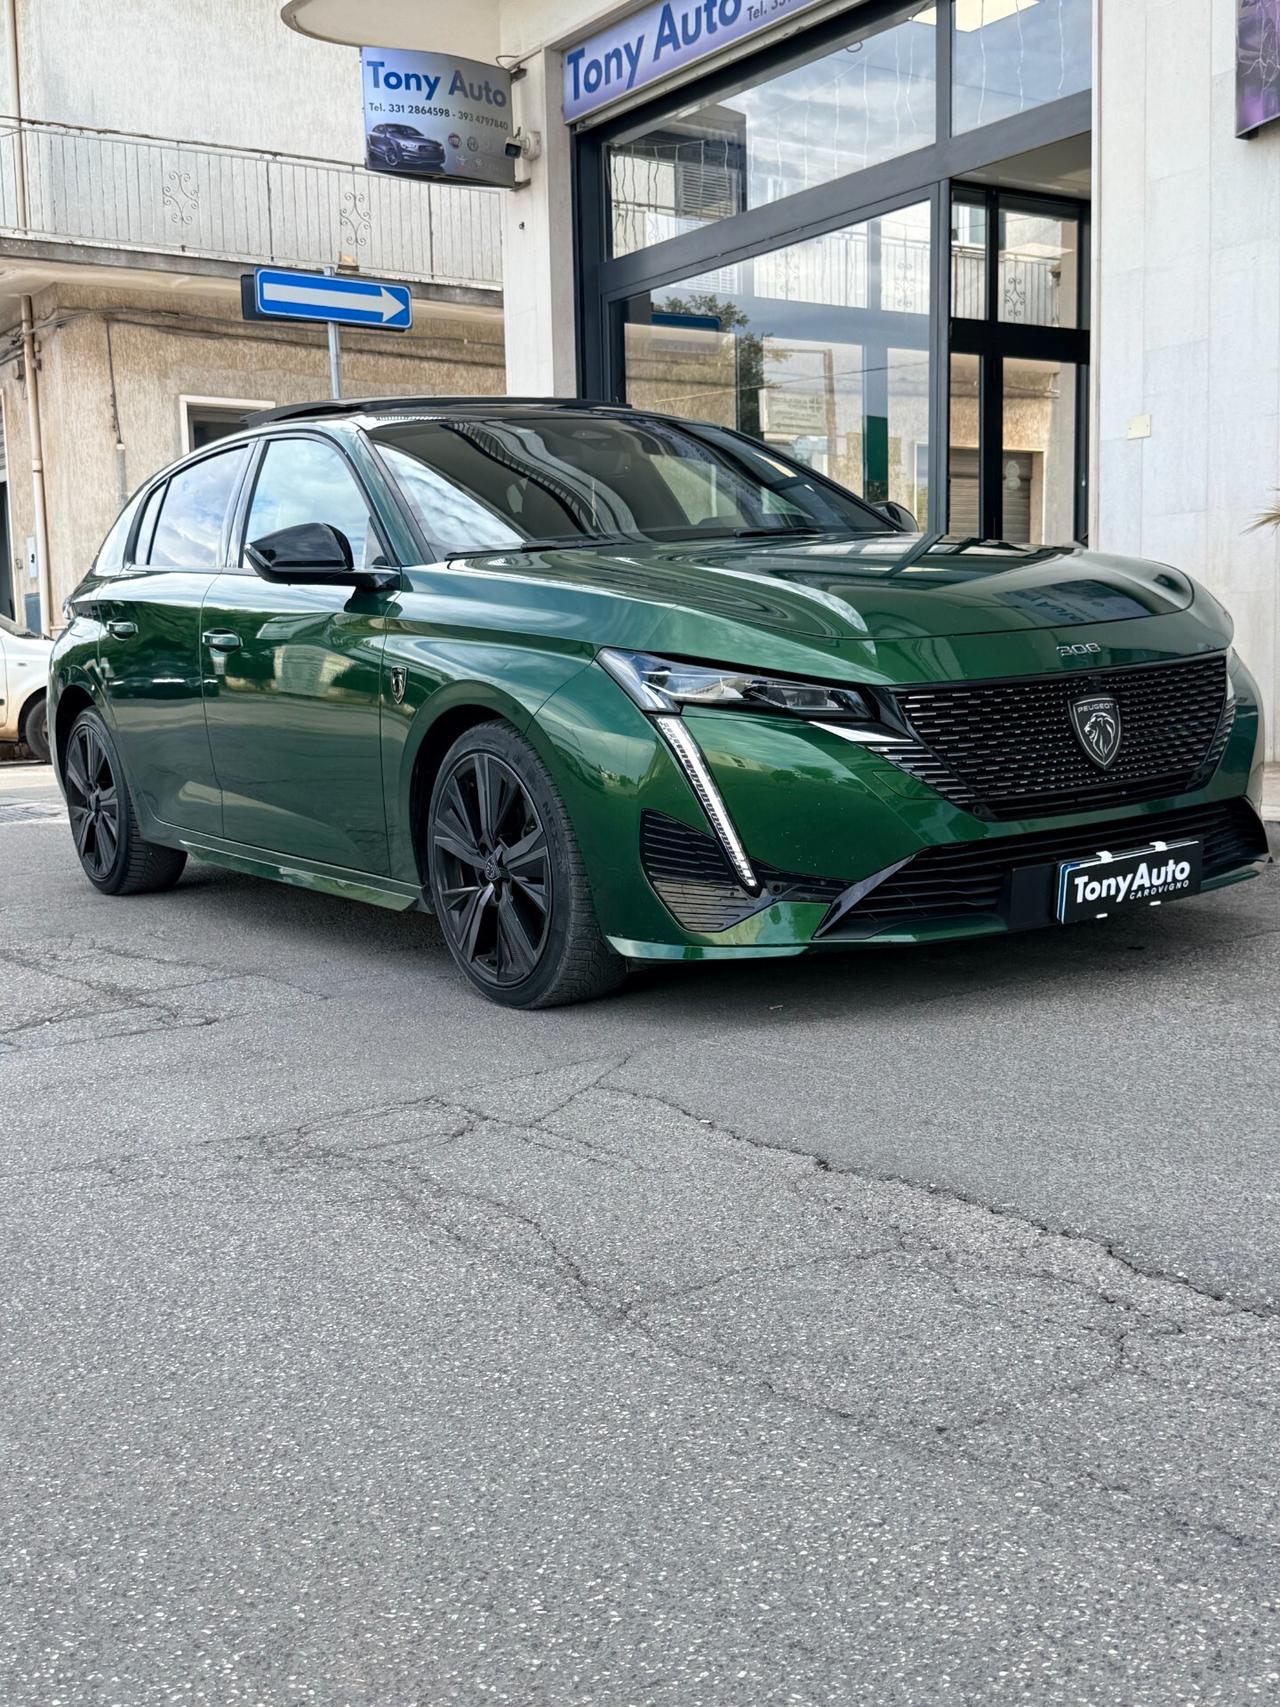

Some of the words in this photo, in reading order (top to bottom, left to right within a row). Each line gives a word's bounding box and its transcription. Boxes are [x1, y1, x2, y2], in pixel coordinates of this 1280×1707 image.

[746, 0, 767, 21] Tel.
[567, 34, 645, 101] Tony
[652, 0, 742, 63] Auto
[366, 60, 441, 101] Tony
[448, 69, 507, 108] Auto
[369, 102, 386, 113] Tel.
[388, 103, 405, 114] 331
[408, 104, 450, 118] 2864598
[458, 110, 474, 122] 393
[1056, 642, 1101, 657] 308
[1077, 702, 1114, 713] PEUGEOT
[1129, 879, 1190, 900] CAROVIGNO
